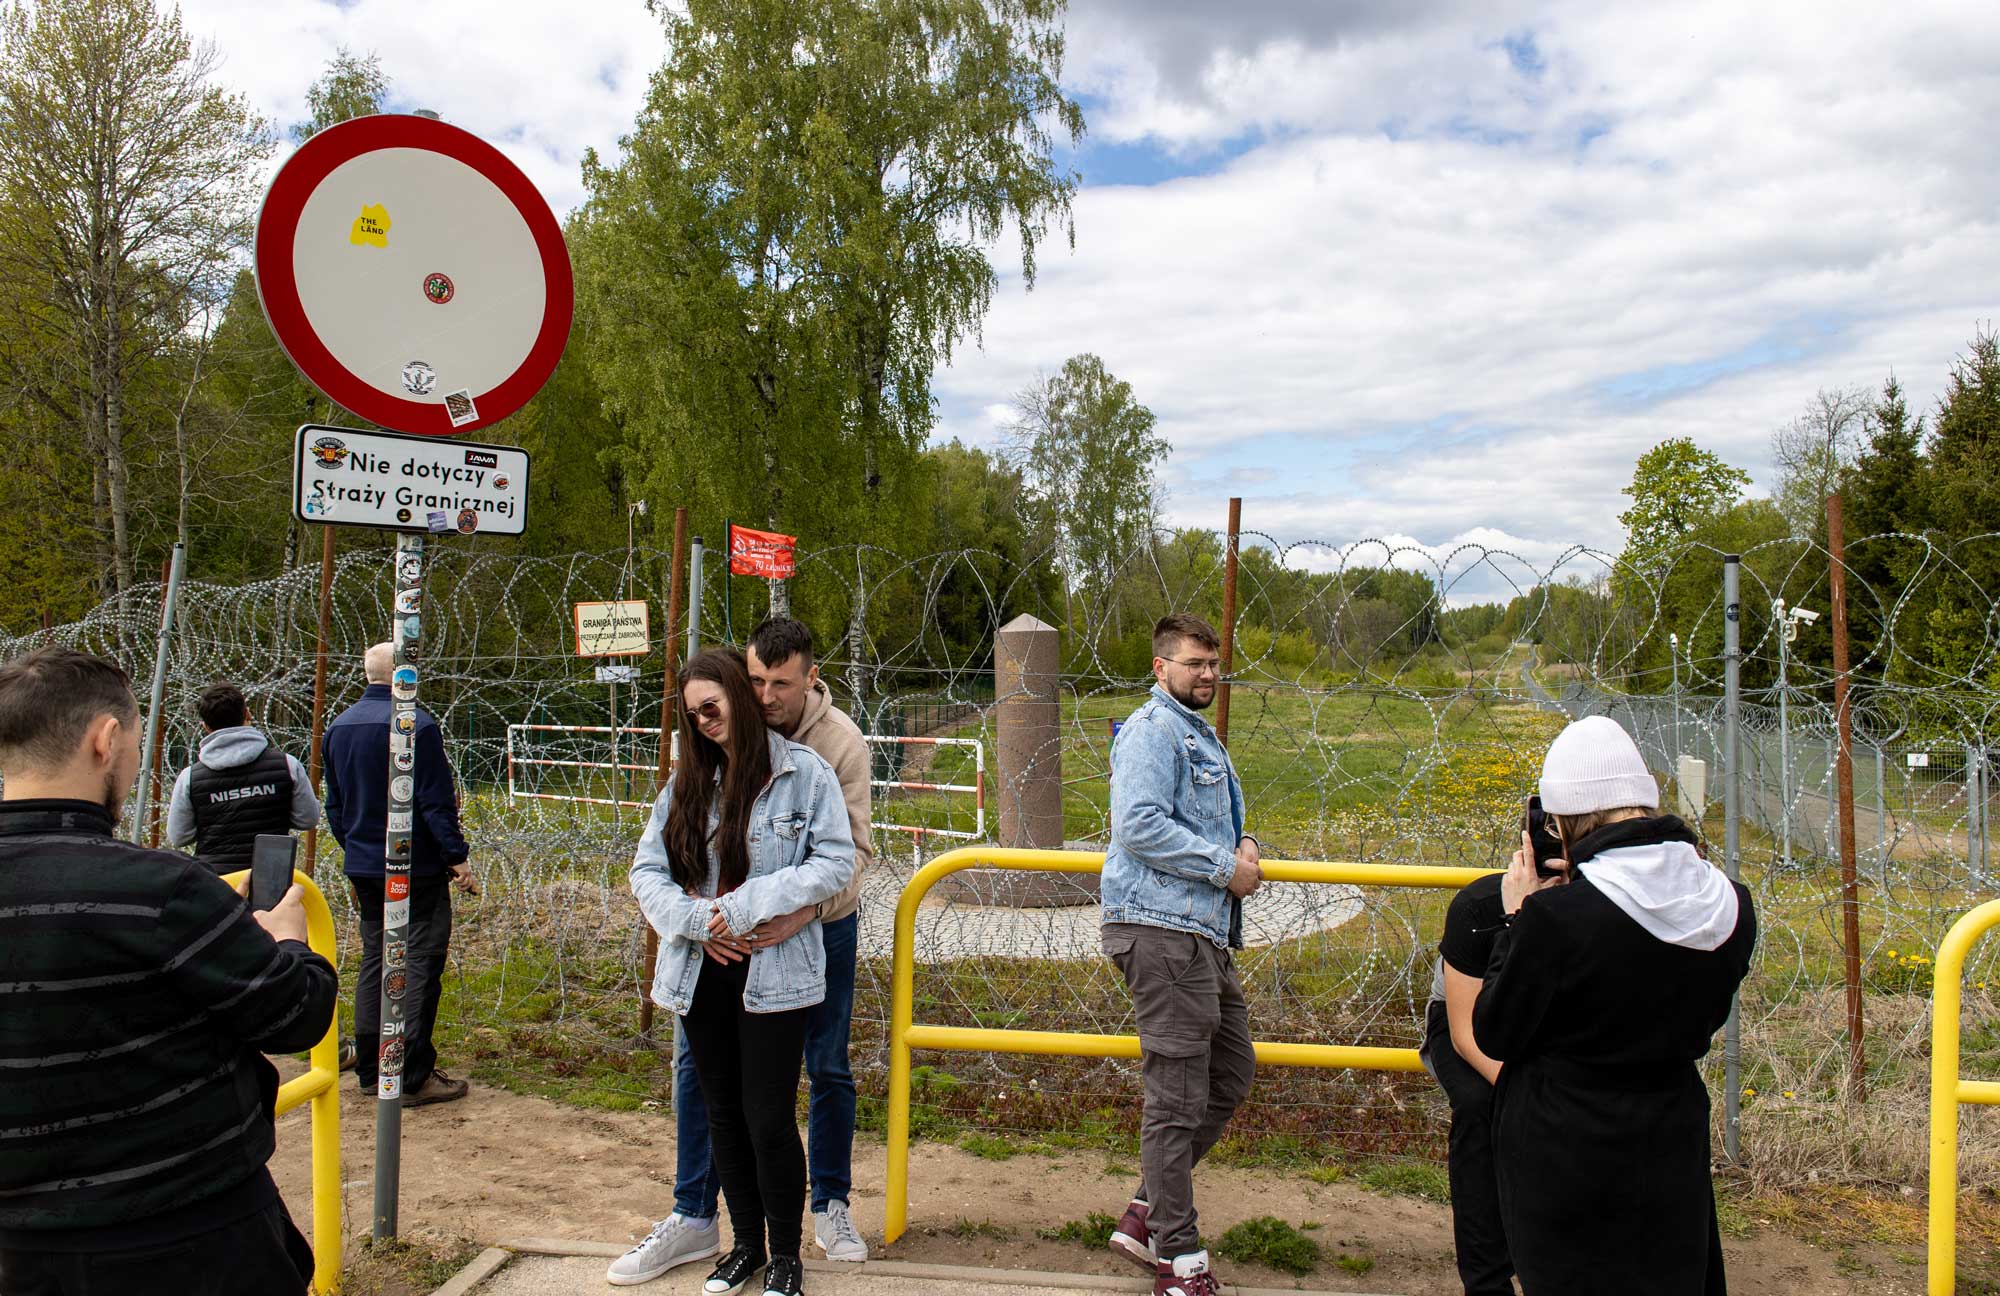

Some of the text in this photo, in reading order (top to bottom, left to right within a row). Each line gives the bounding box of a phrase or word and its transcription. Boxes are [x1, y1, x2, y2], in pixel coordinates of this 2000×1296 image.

[361, 217, 377, 225] THE
[468, 454, 496, 464] JAWA
[350, 452, 485, 488] Nie dotyczy
[312, 479, 516, 519] Straży Granicznej
[210, 784, 276, 803] NISSAN
